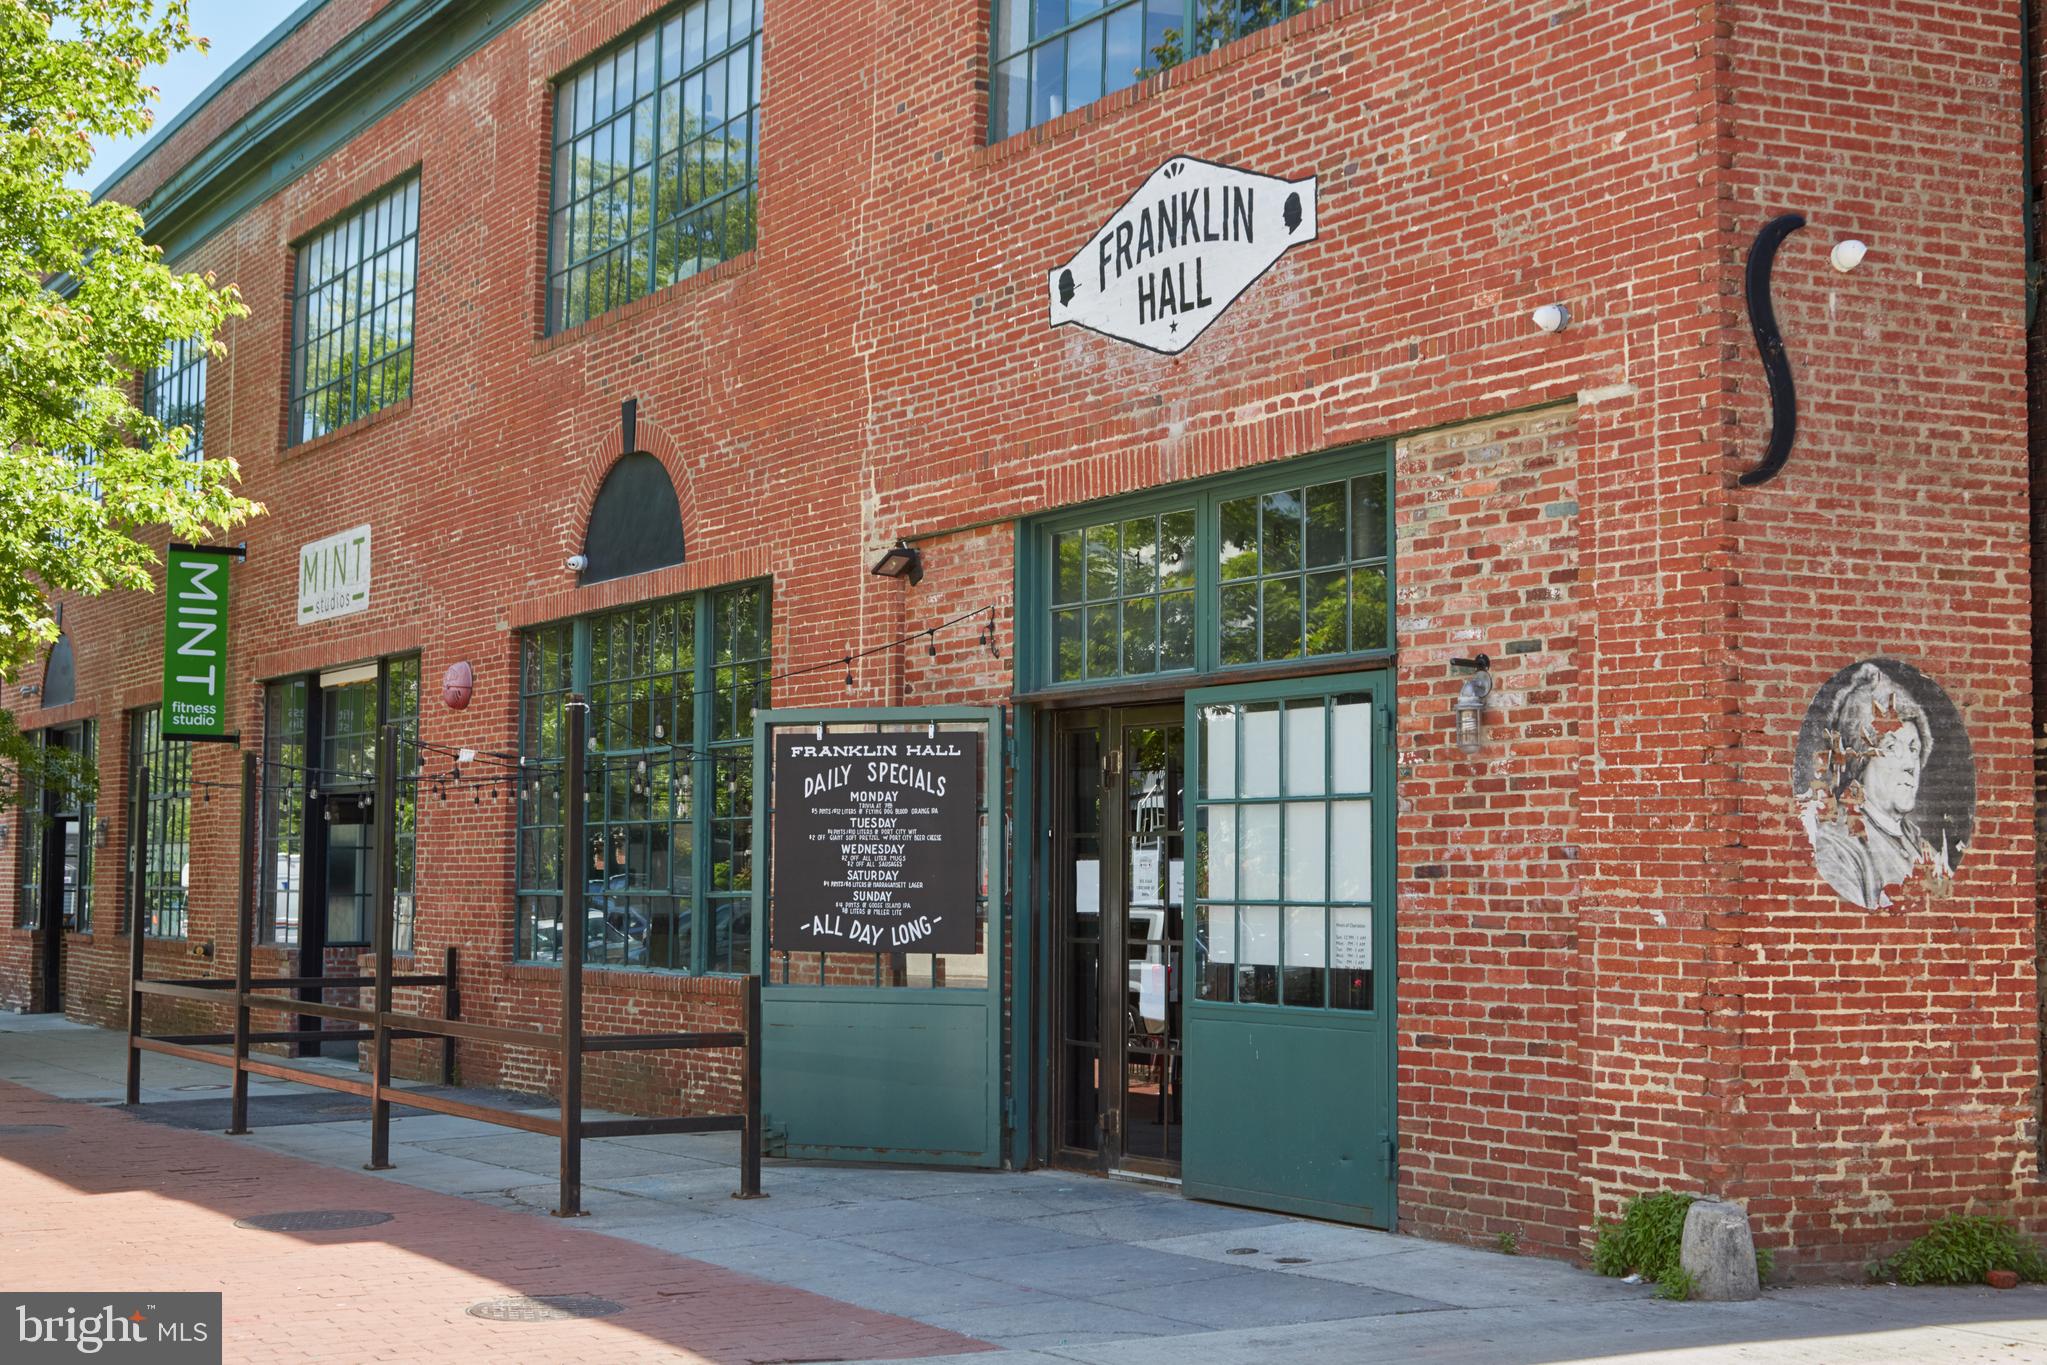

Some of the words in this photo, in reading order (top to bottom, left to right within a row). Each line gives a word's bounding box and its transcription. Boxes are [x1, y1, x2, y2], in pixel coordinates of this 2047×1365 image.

[1099, 186, 1254, 293] FRANKLIN
[1138, 256, 1212, 325] HALL
[303, 537, 365, 597] MINT
[315, 592, 350, 614] studios
[176, 562, 219, 696] MINT
[172, 701, 216, 714] fitness
[172, 714, 215, 726] studio
[791, 745, 897, 758] FRANKLIN
[906, 745, 961, 756] HALL
[804, 764, 852, 798] DAILY
[867, 762, 946, 797] SPECIALS
[850, 791, 899, 802] MONDAY
[850, 817, 898, 828] TUESDAY
[841, 844, 905, 855] WEDNESDAY
[847, 870, 899, 881] SATURDAY
[853, 890, 893, 902] SUNDAY
[849, 919, 884, 946] DAY
